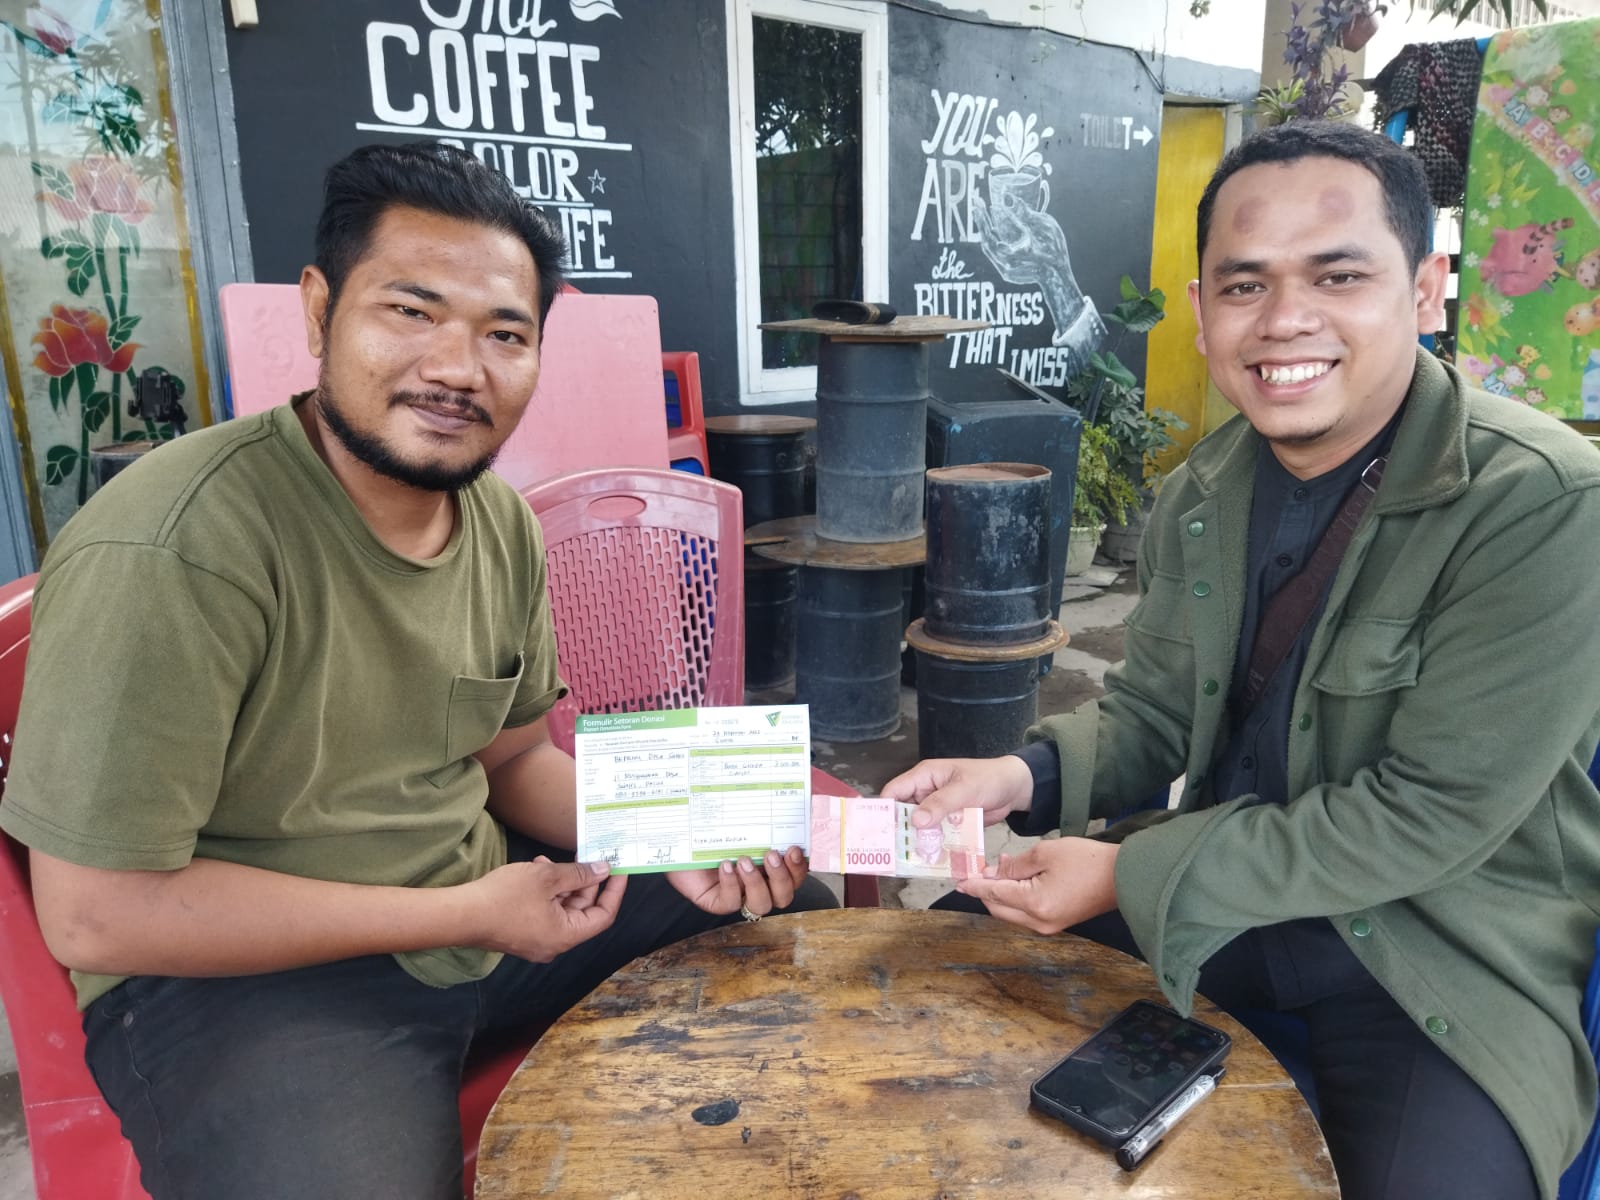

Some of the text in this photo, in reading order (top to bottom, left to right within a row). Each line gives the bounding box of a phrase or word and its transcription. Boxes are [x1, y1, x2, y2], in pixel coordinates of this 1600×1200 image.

[366, 21, 606, 140] COFFEE
[921, 89, 998, 158] YOU
[1080, 113, 1133, 150] TOILET
[911, 158, 989, 243] ARE
[932, 247, 974, 279] the
[914, 281, 1044, 326] BITTERNESS
[946, 327, 1012, 368] THAT
[1020, 347, 1069, 387] MISS
[583, 719, 612, 727] Formulir
[614, 716, 641, 725] Setoran
[847, 853, 891, 865] 100000
